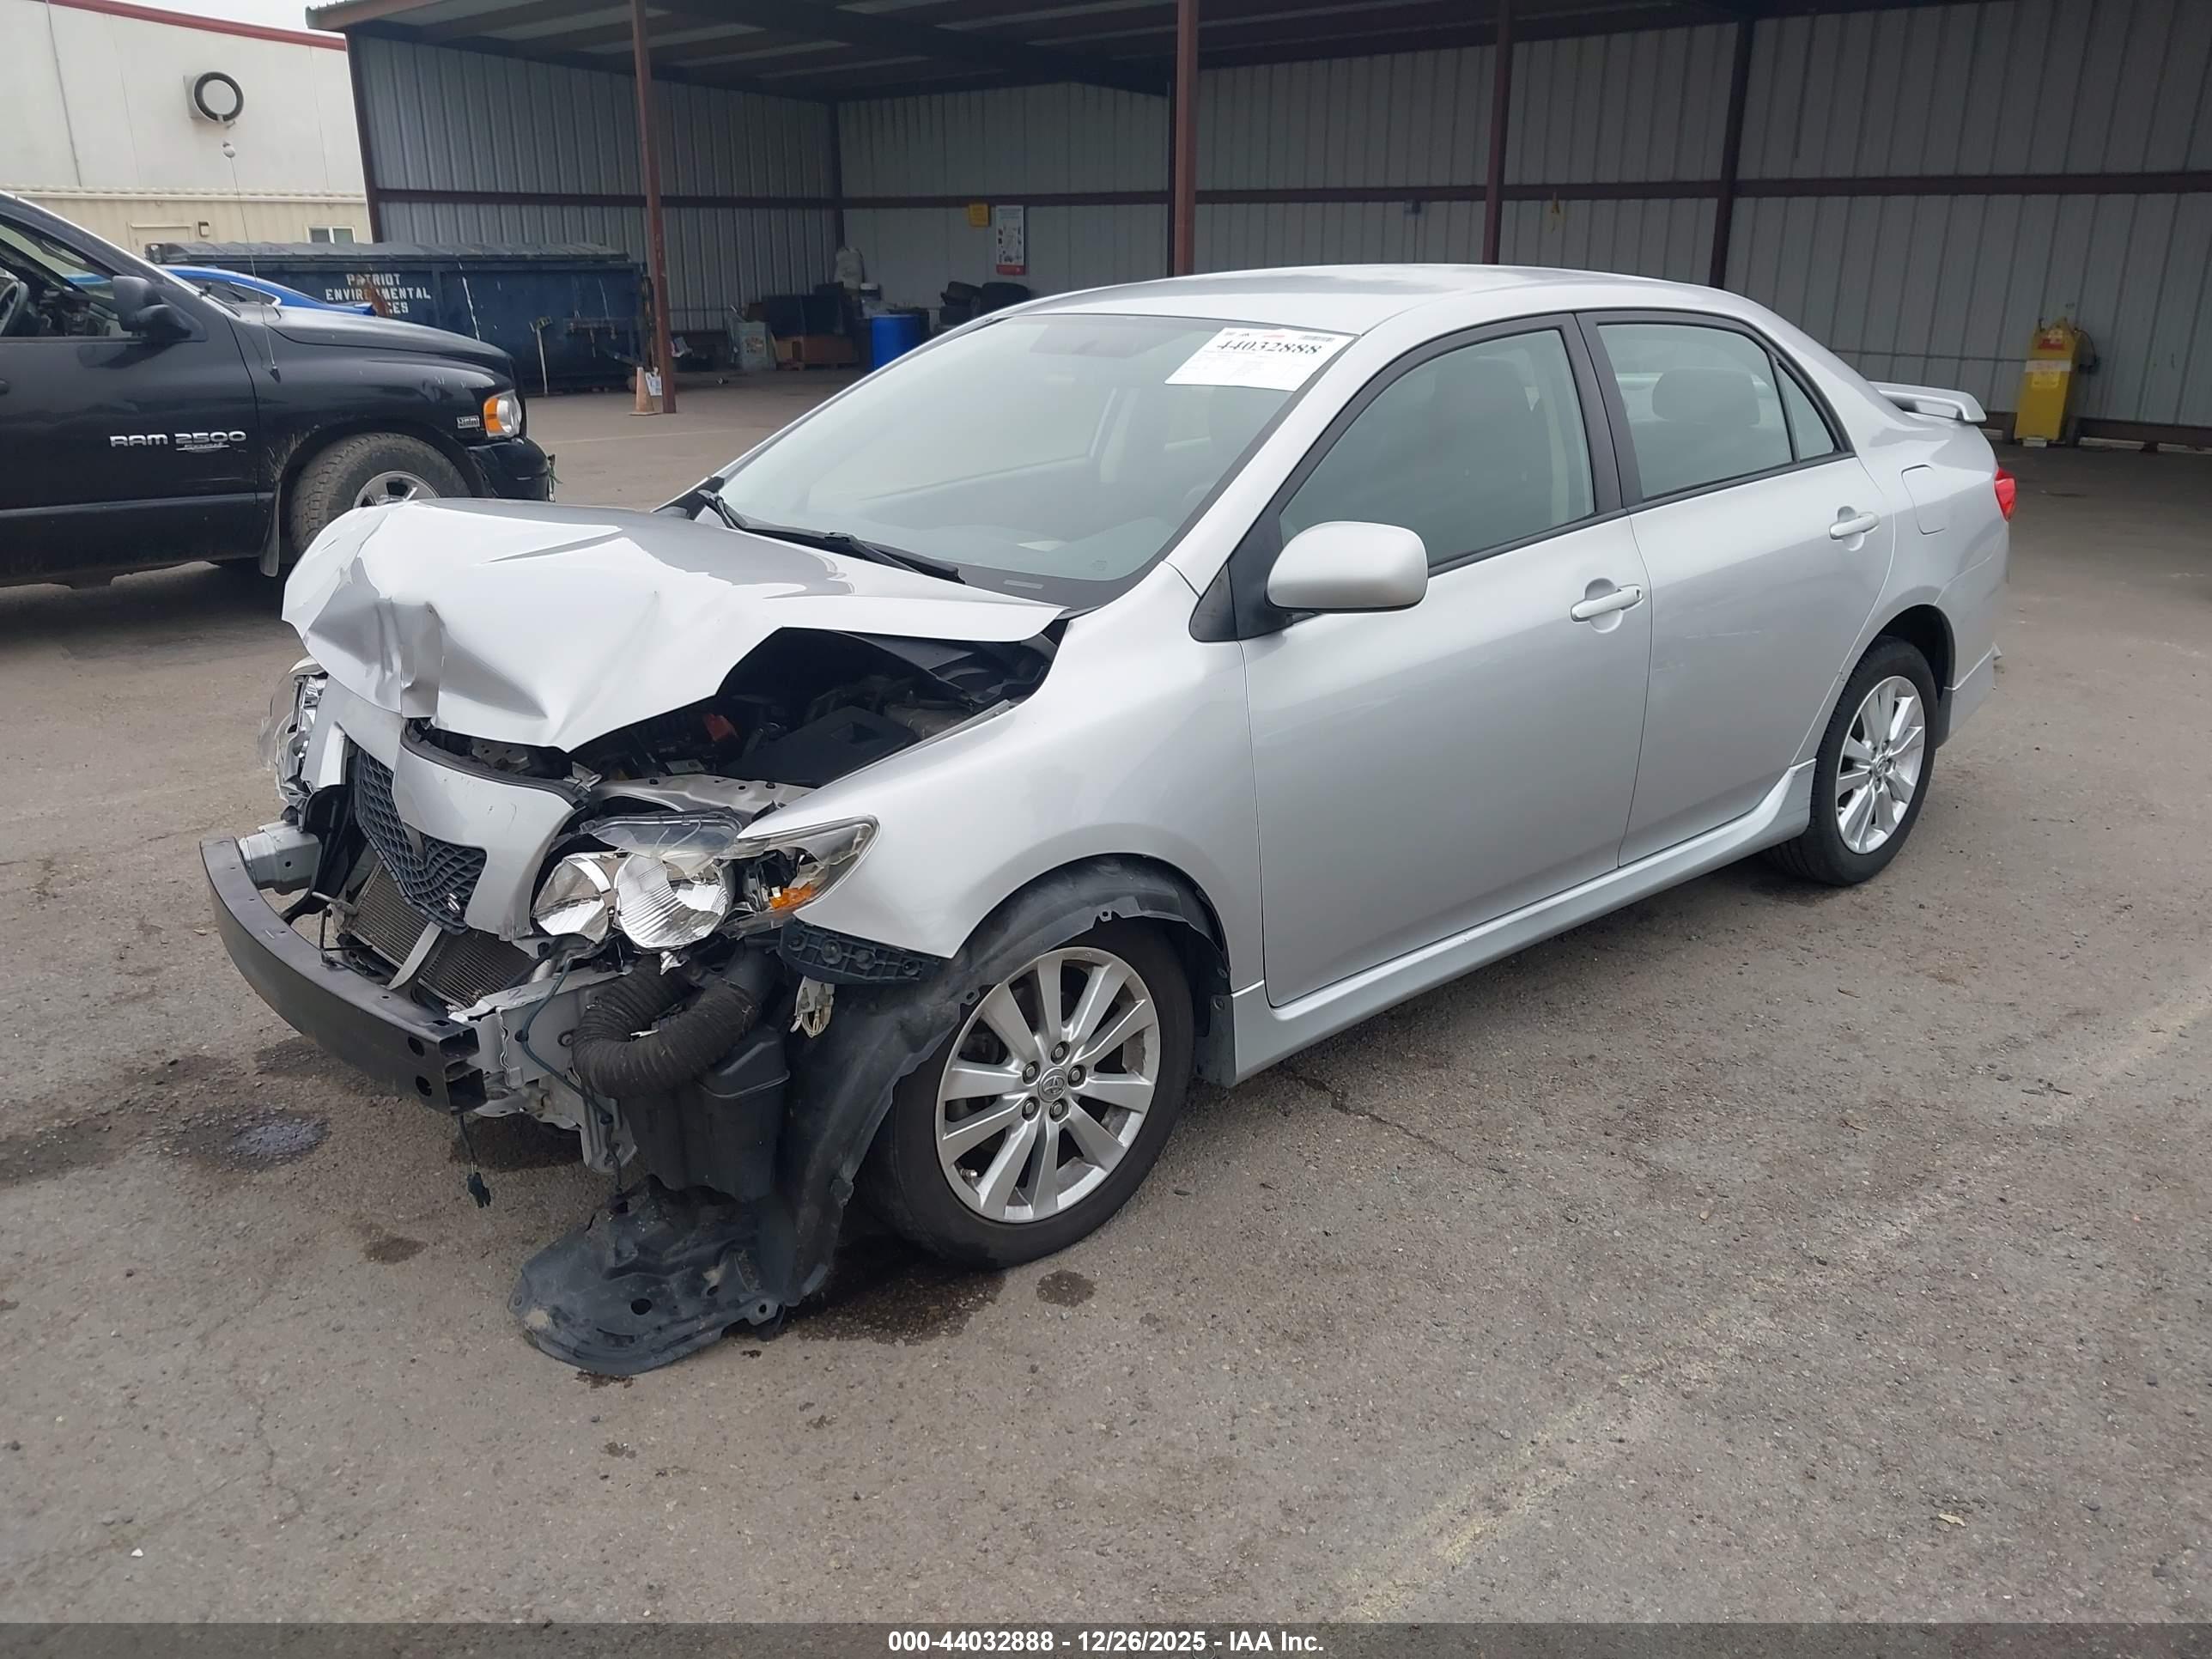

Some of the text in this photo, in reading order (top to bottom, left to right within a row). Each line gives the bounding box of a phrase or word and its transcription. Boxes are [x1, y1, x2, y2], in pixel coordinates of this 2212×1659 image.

[346, 273, 401, 285] PATRIOT
[325, 287, 431, 301] ENVIROMENTAL
[1217, 339, 1322, 355] 44032888
[109, 431, 246, 447] RAM 2500
